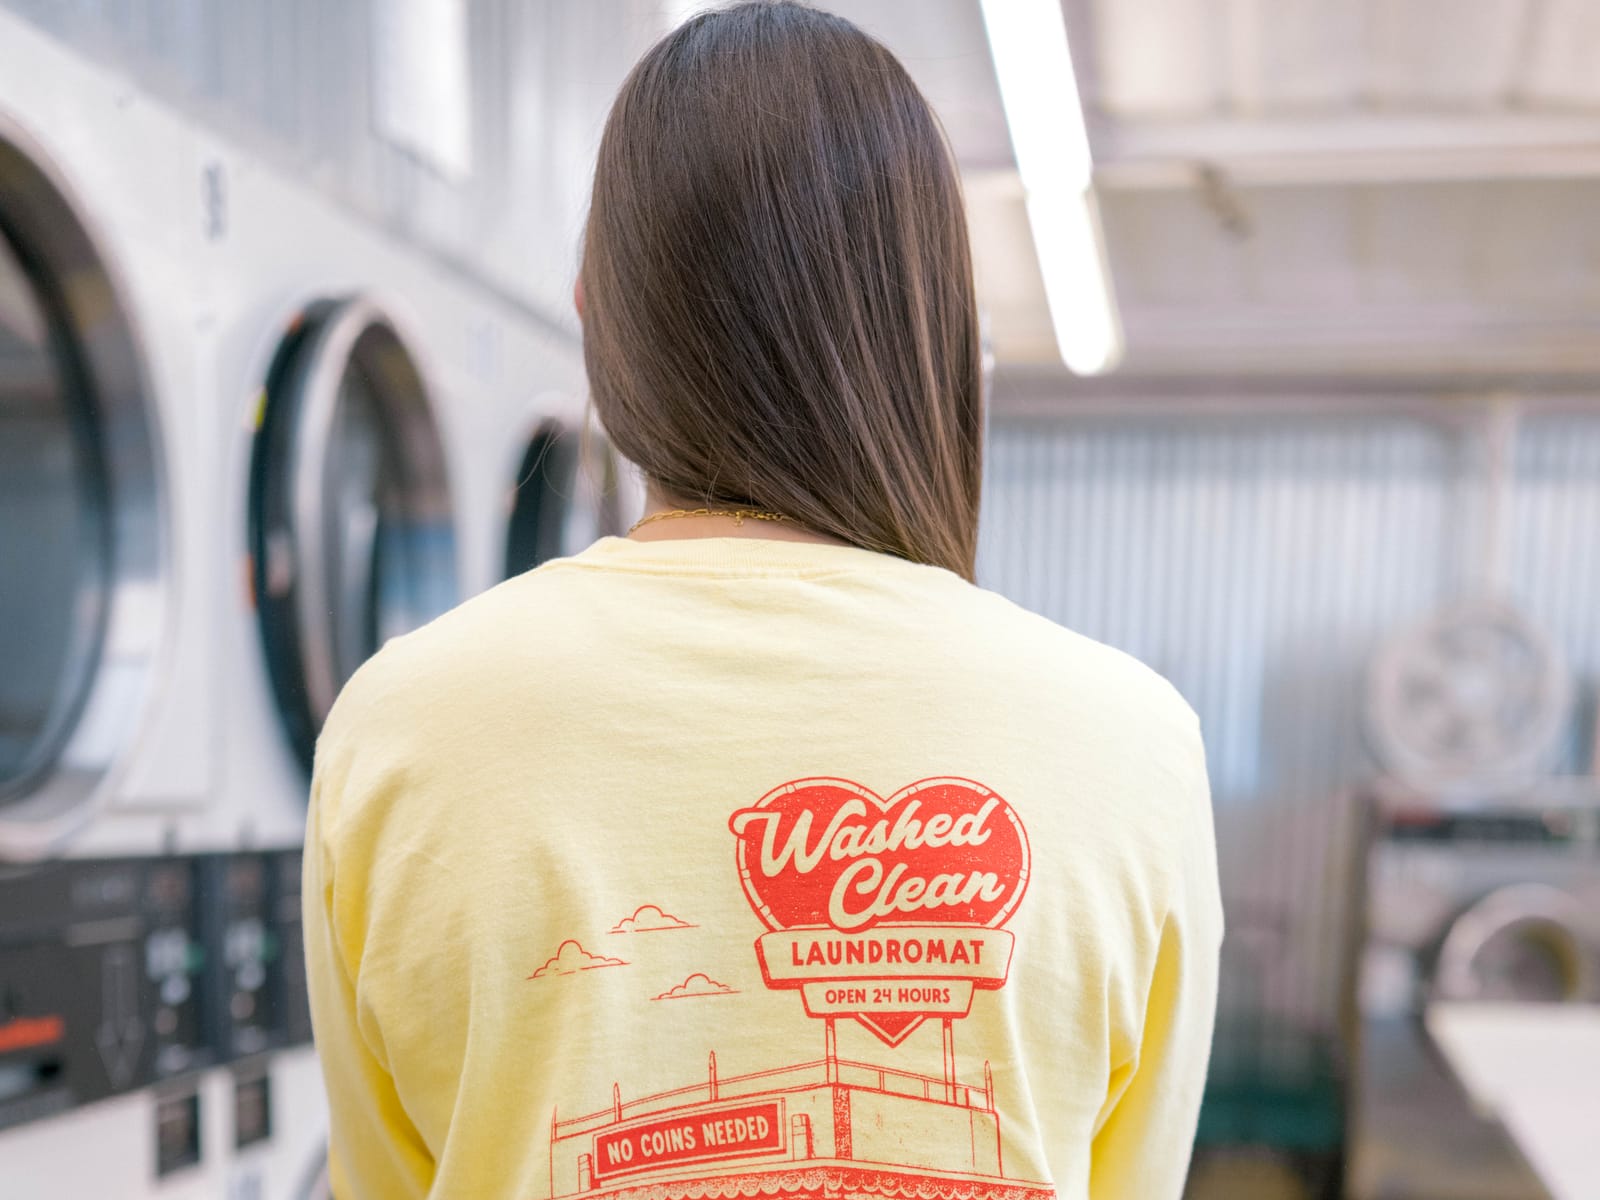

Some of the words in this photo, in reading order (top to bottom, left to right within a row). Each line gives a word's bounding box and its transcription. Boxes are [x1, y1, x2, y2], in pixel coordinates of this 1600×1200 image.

[734, 798, 998, 877] Washed
[829, 858, 1005, 929] Clean
[792, 939, 984, 966] LAUNDROMAT
[825, 988, 866, 1004] OPEN
[873, 988, 892, 1003] 24
[898, 988, 950, 1003] HOURS
[607, 1138, 633, 1165] NO
[640, 1126, 696, 1157] COINS
[702, 1115, 769, 1147] NEEDED
